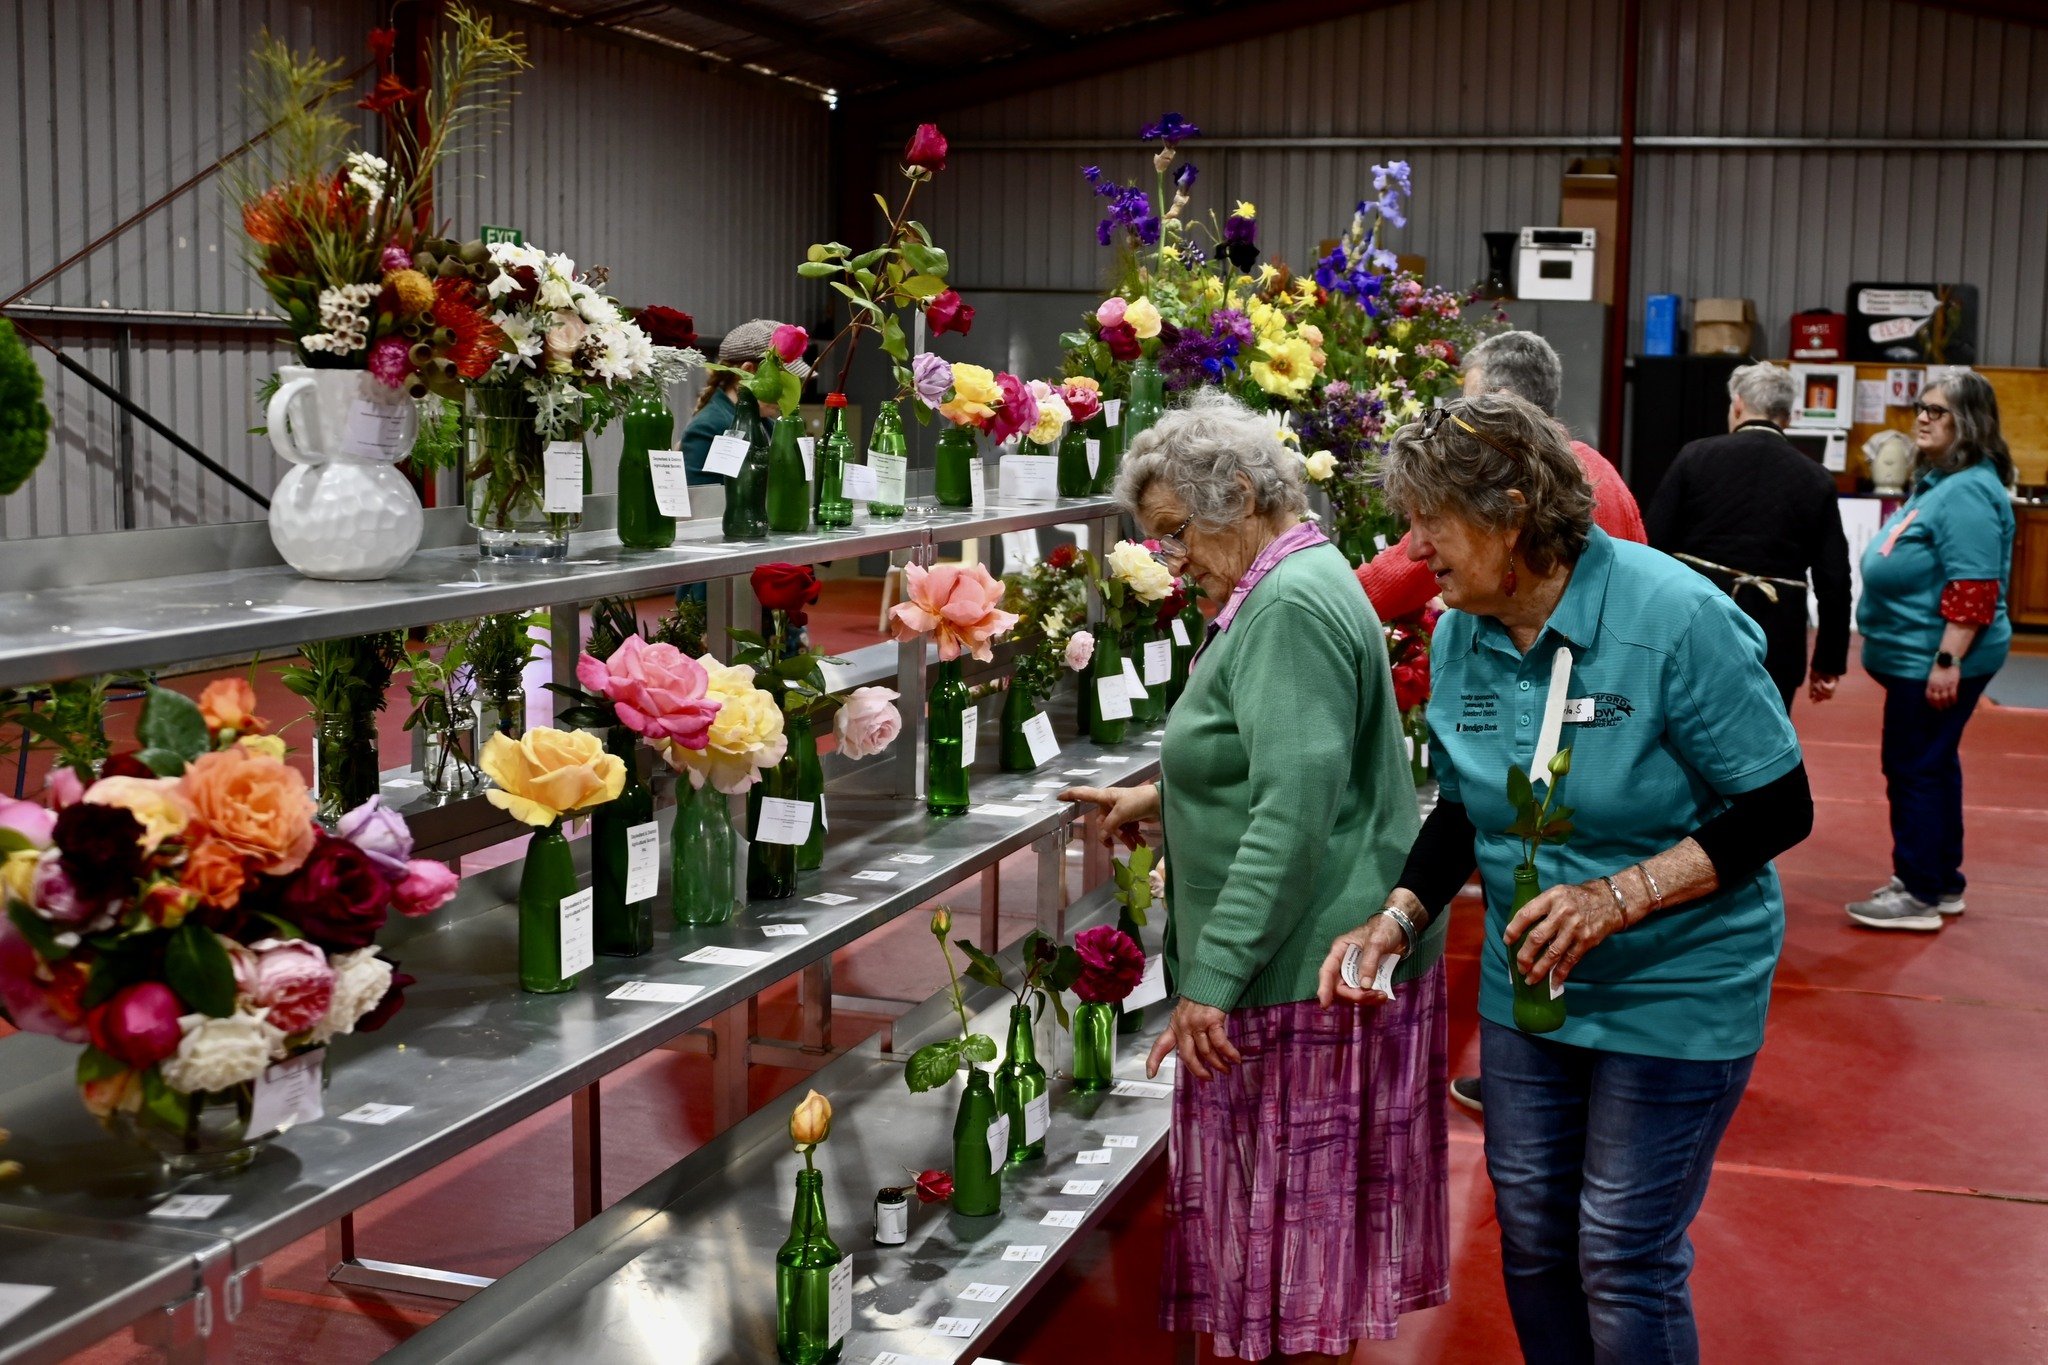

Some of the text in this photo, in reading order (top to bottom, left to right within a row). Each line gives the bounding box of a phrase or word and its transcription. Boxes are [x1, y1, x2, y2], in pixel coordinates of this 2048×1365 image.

[487, 229, 517, 244] EXIT
[1595, 708, 1616, 717] OW
[1463, 723, 1498, 733] Bendigo Bank
